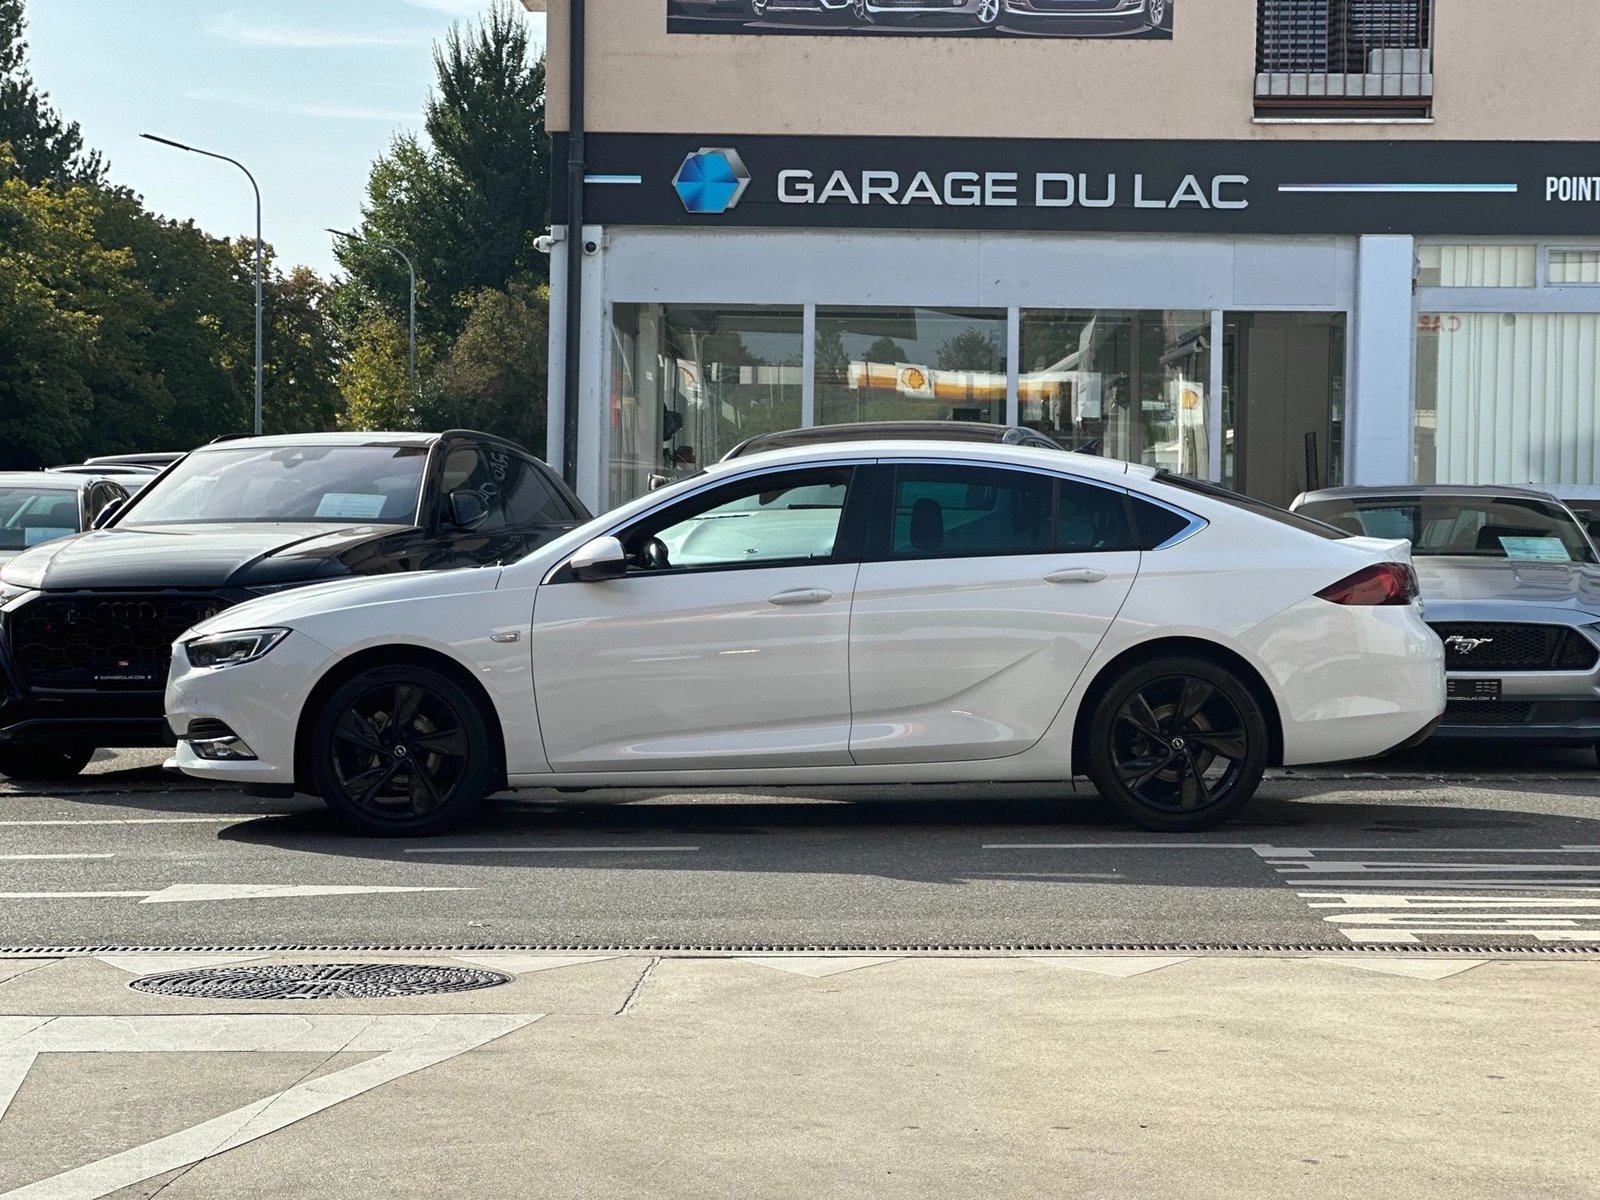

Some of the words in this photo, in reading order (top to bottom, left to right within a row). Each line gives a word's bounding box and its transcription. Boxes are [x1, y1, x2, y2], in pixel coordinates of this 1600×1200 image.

[778, 169, 1018, 206] GARAGE
[1035, 172, 1116, 208] DU
[1134, 173, 1249, 209] LAC
[1545, 176, 1600, 202] POINT
